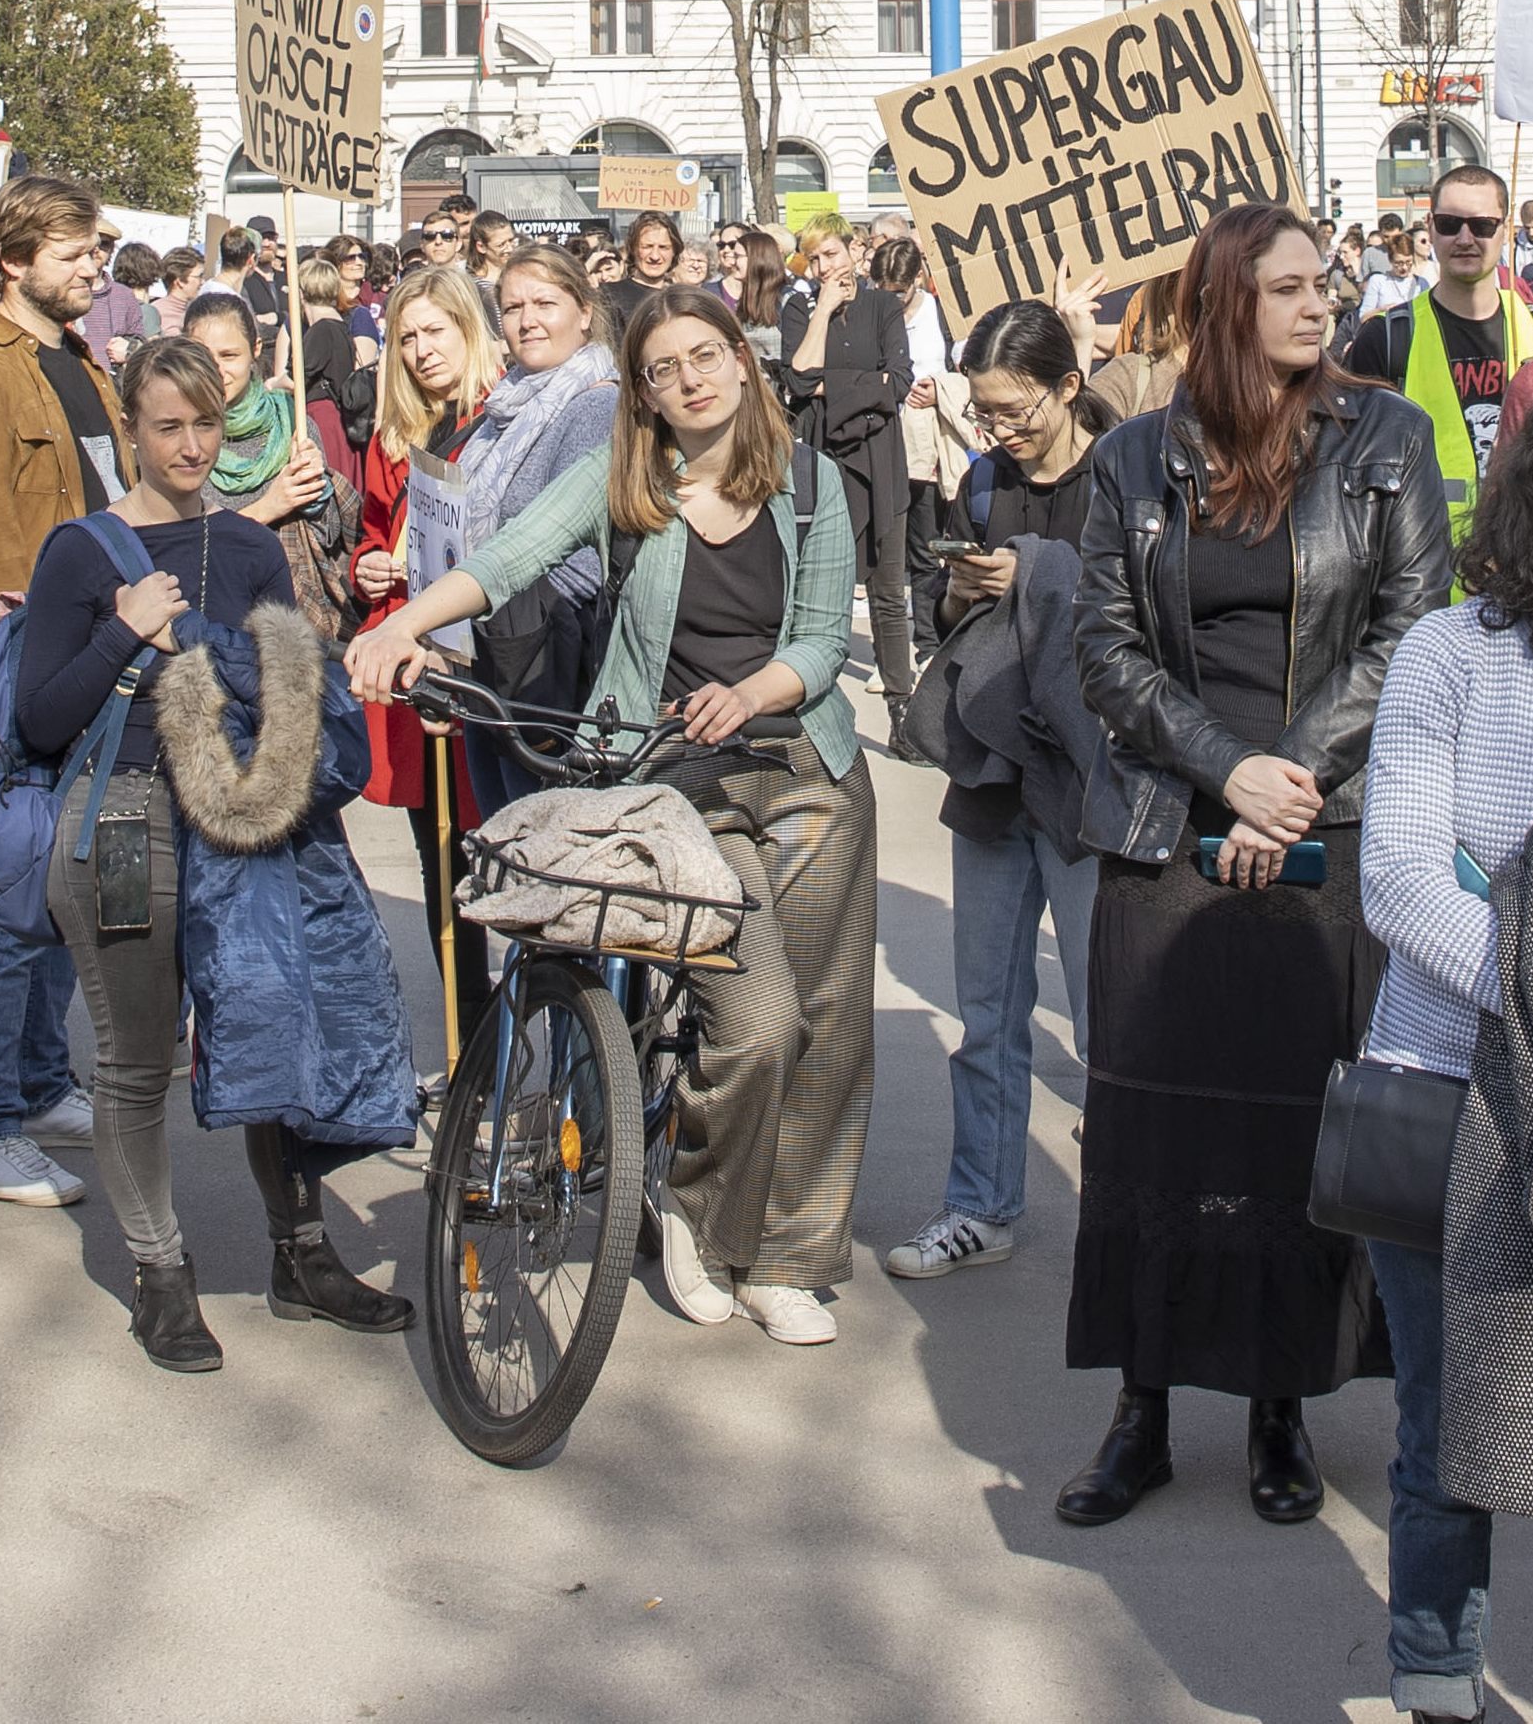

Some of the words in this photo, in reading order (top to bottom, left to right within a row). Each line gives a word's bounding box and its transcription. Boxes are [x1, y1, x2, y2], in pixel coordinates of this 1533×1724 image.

[247, 22, 353, 119] OASCH
[245, 93, 383, 199] VERTRÄGE?
[1041, 137, 1116, 186] IM
[513, 221, 581, 234] VOTIVPARK
[605, 186, 691, 208] WÜTEND
[930, 111, 1290, 319] MITTELBAU
